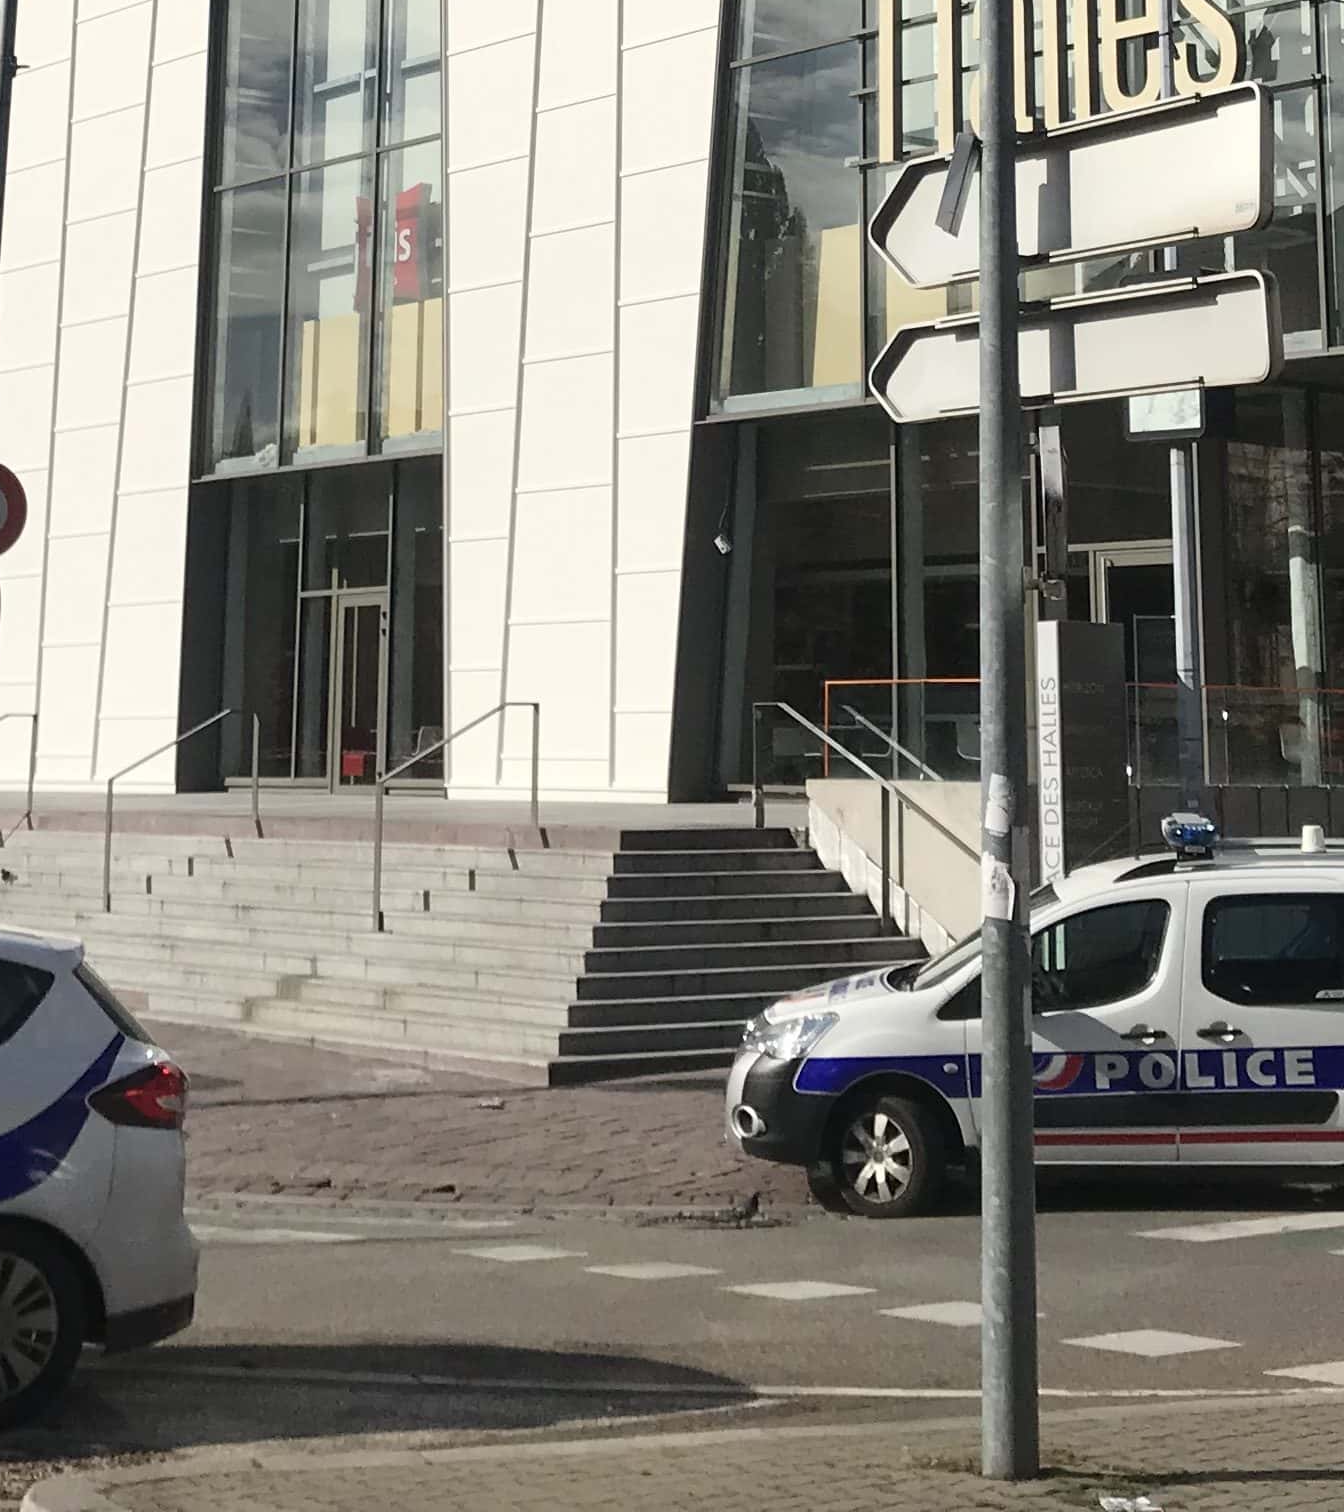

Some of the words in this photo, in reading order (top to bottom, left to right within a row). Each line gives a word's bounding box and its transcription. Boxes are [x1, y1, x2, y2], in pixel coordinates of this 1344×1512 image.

[1040, 676, 1059, 768] HALLES
[1043, 777, 1060, 825] DES
[1094, 1049, 1315, 1089] POLICE
